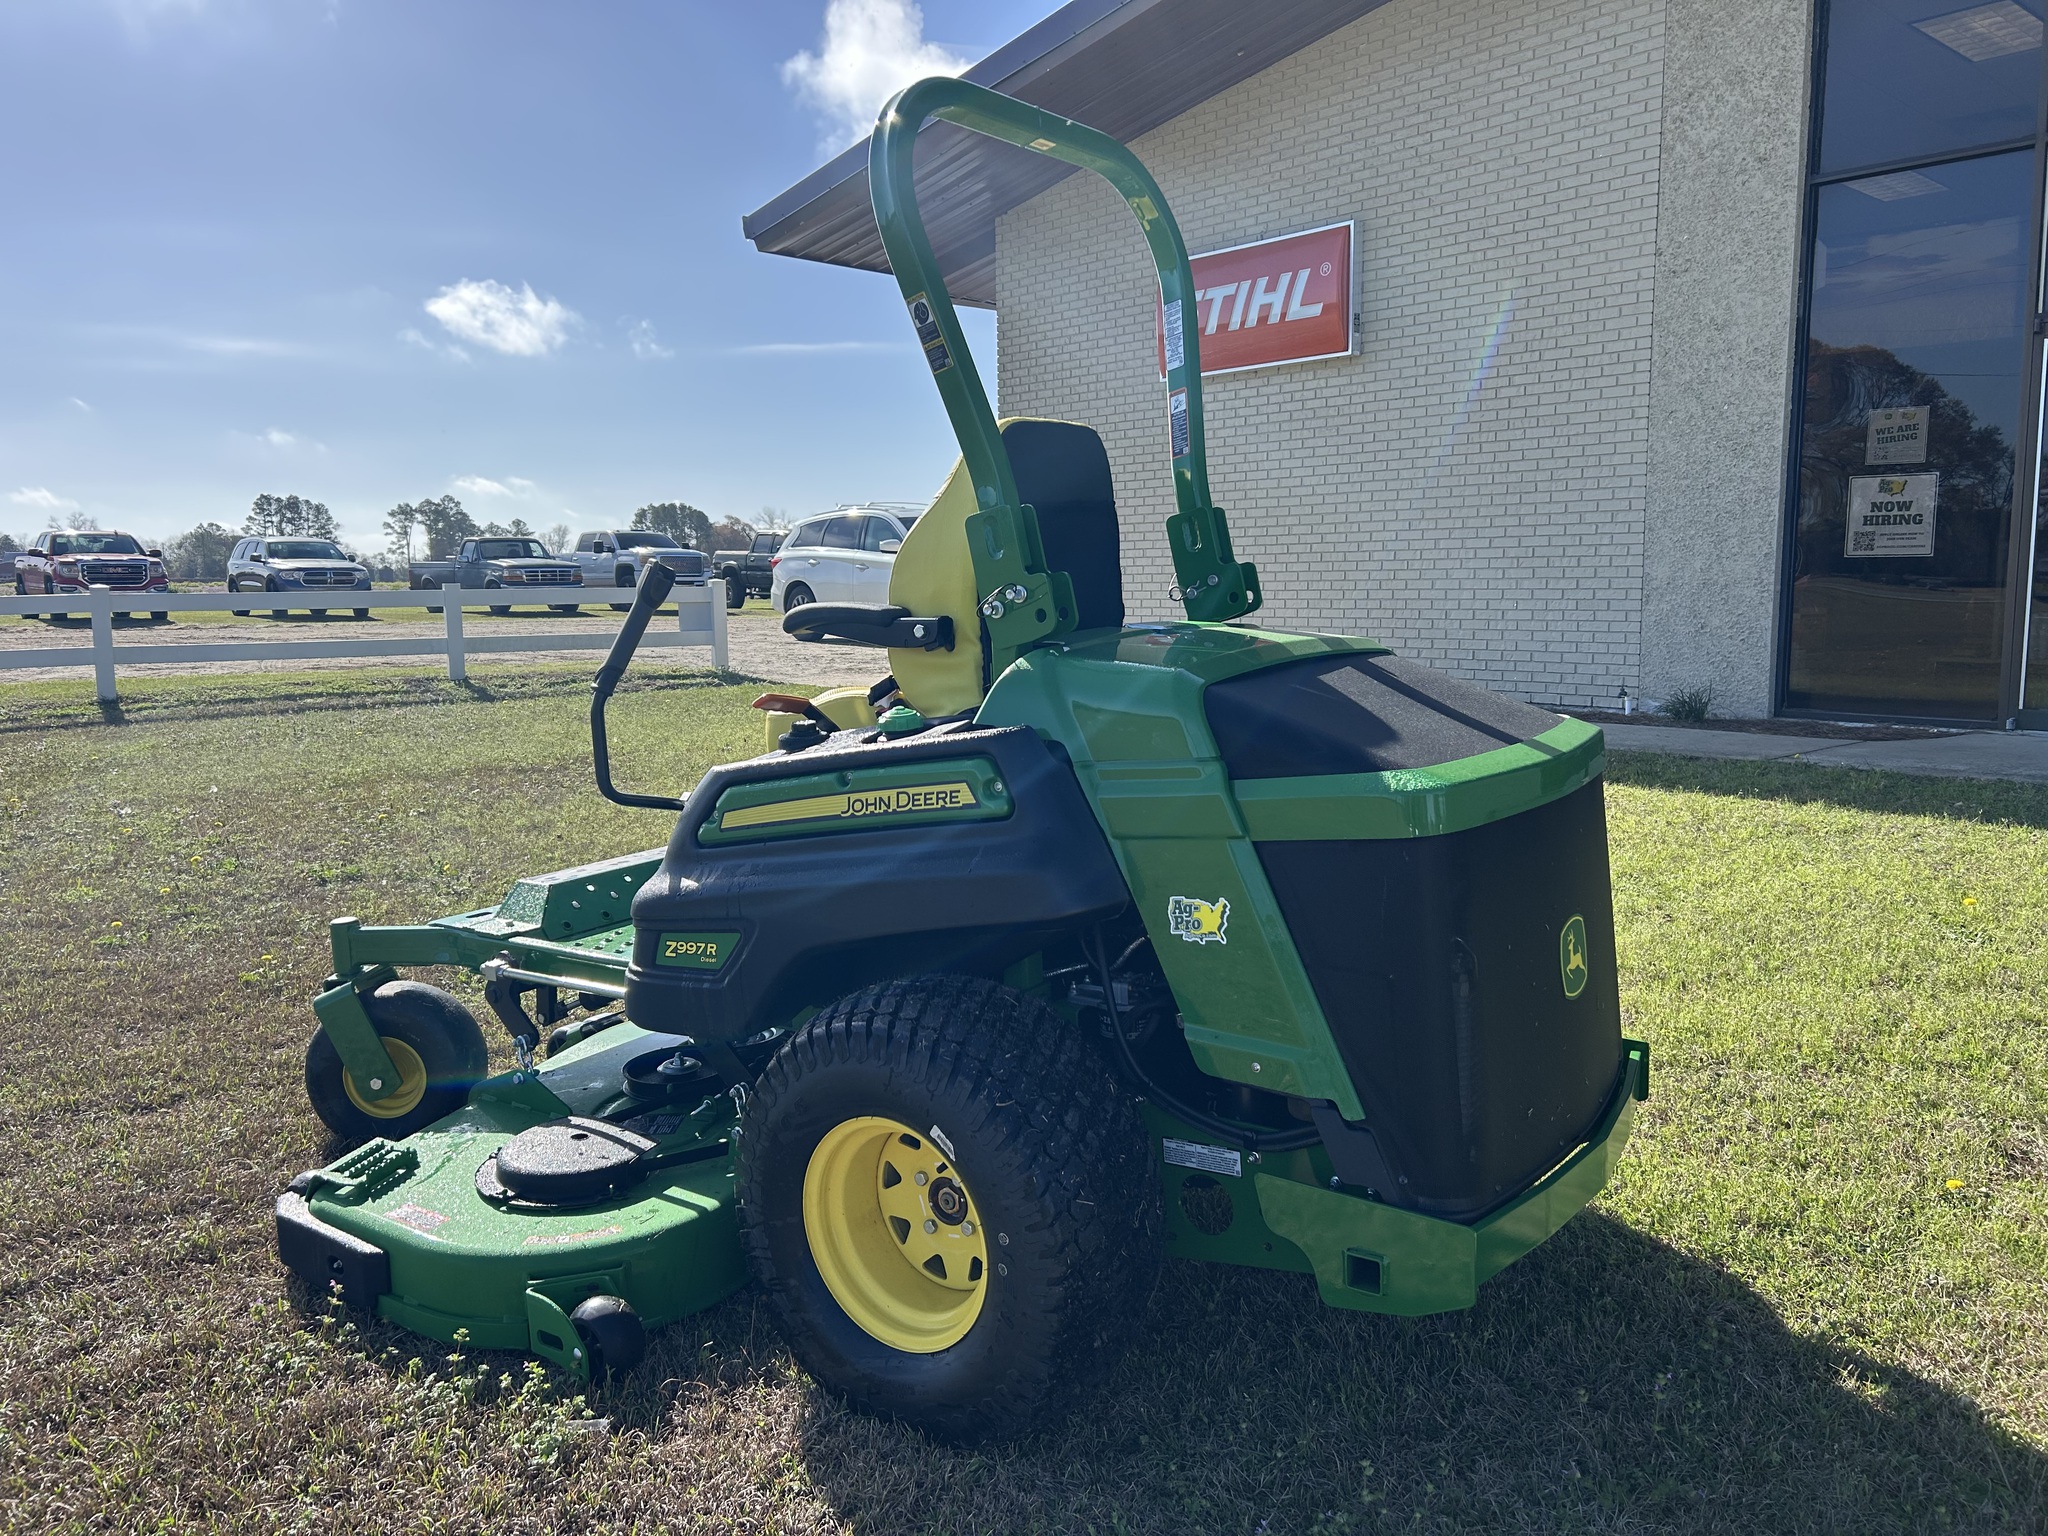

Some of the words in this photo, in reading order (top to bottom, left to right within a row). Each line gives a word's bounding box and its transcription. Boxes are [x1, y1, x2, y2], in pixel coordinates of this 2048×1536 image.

[1195, 268, 1324, 336] TIHL
[1875, 426, 1894, 436] WE
[1896, 423, 1920, 433] ARE
[1876, 432, 1918, 445] HIRING
[1870, 500, 1914, 513] NOW
[1862, 513, 1924, 527] HIRING
[840, 794, 891, 816] JOHN
[895, 789, 961, 809] DEERE
[1172, 899, 1199, 918] Ag-
[1173, 915, 1201, 931] Pro
[665, 941, 717, 957] Z997R
